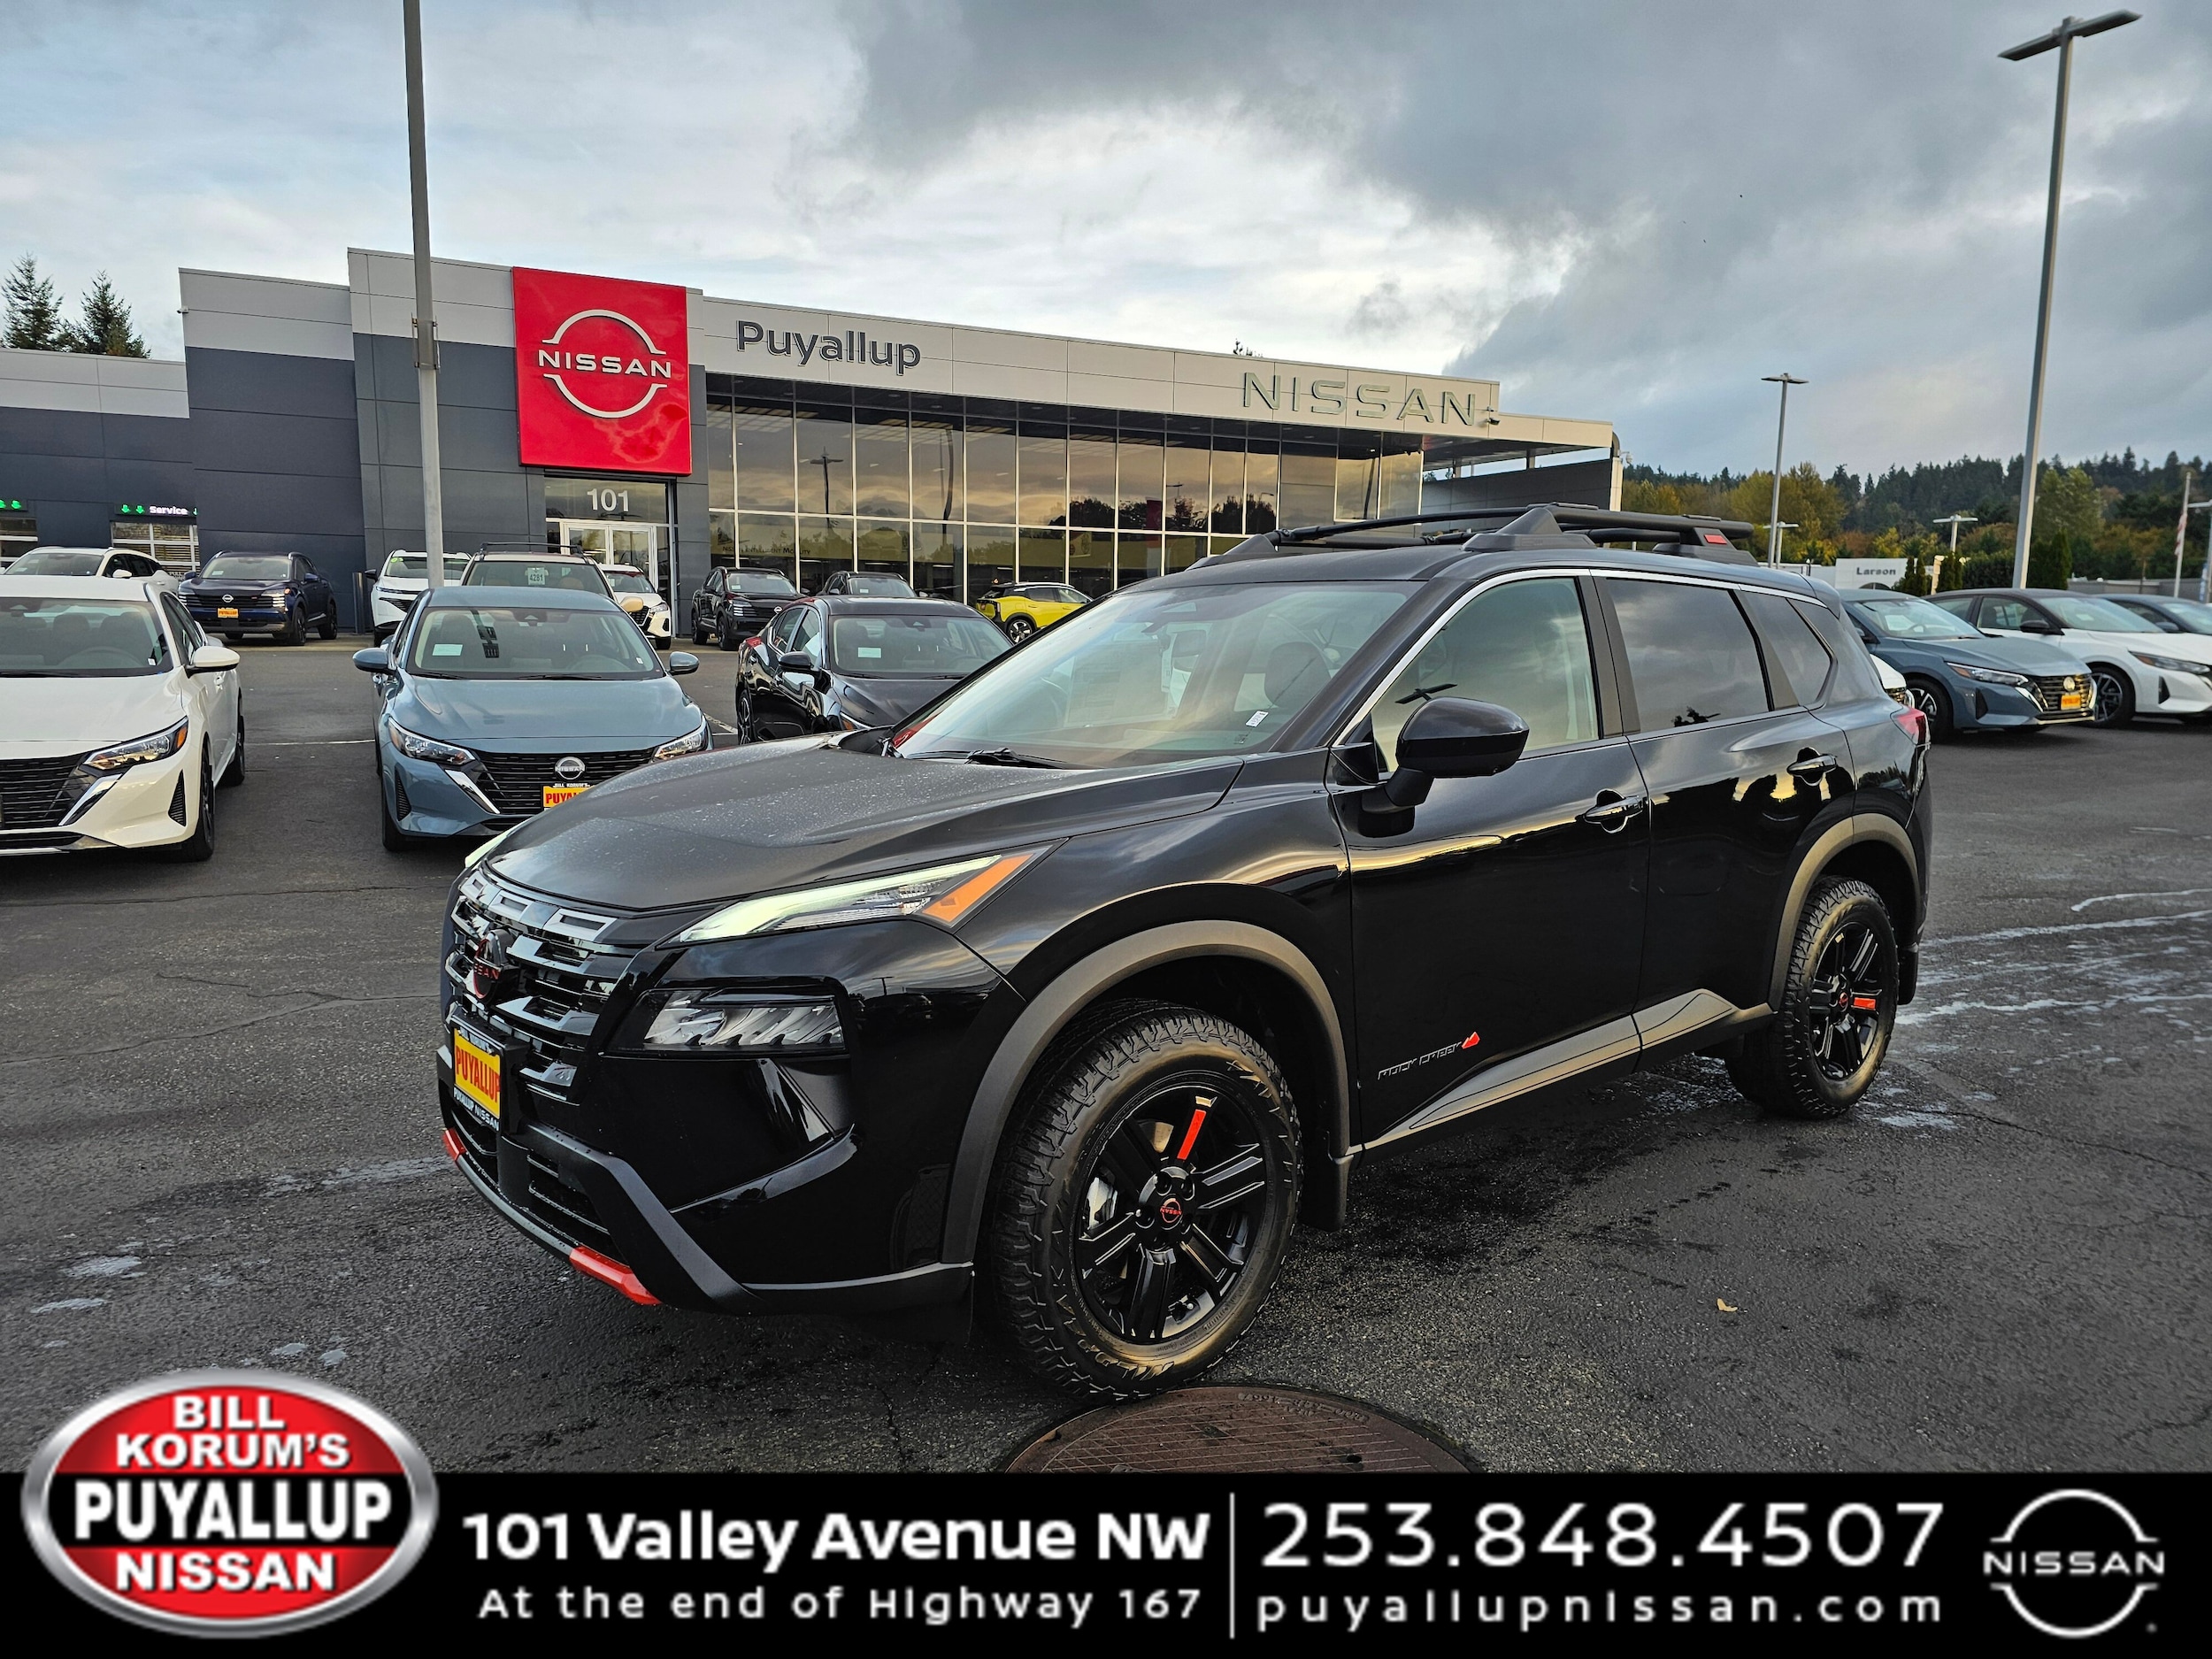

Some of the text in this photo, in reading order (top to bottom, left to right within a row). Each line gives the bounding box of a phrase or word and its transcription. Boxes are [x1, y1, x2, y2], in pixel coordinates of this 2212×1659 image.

[736, 319, 921, 376] Puyallup
[538, 349, 672, 379] NISSAN
[1242, 372, 1476, 426] NISSAN
[149, 505, 188, 515] Service
[587, 488, 629, 512] 101
[1856, 566, 1896, 575] Larson
[455, 1045, 501, 1102] PUYALLUP
[1378, 1041, 1462, 1080] ROCK CREEK
[474, 1104, 500, 1132] NISSAN
